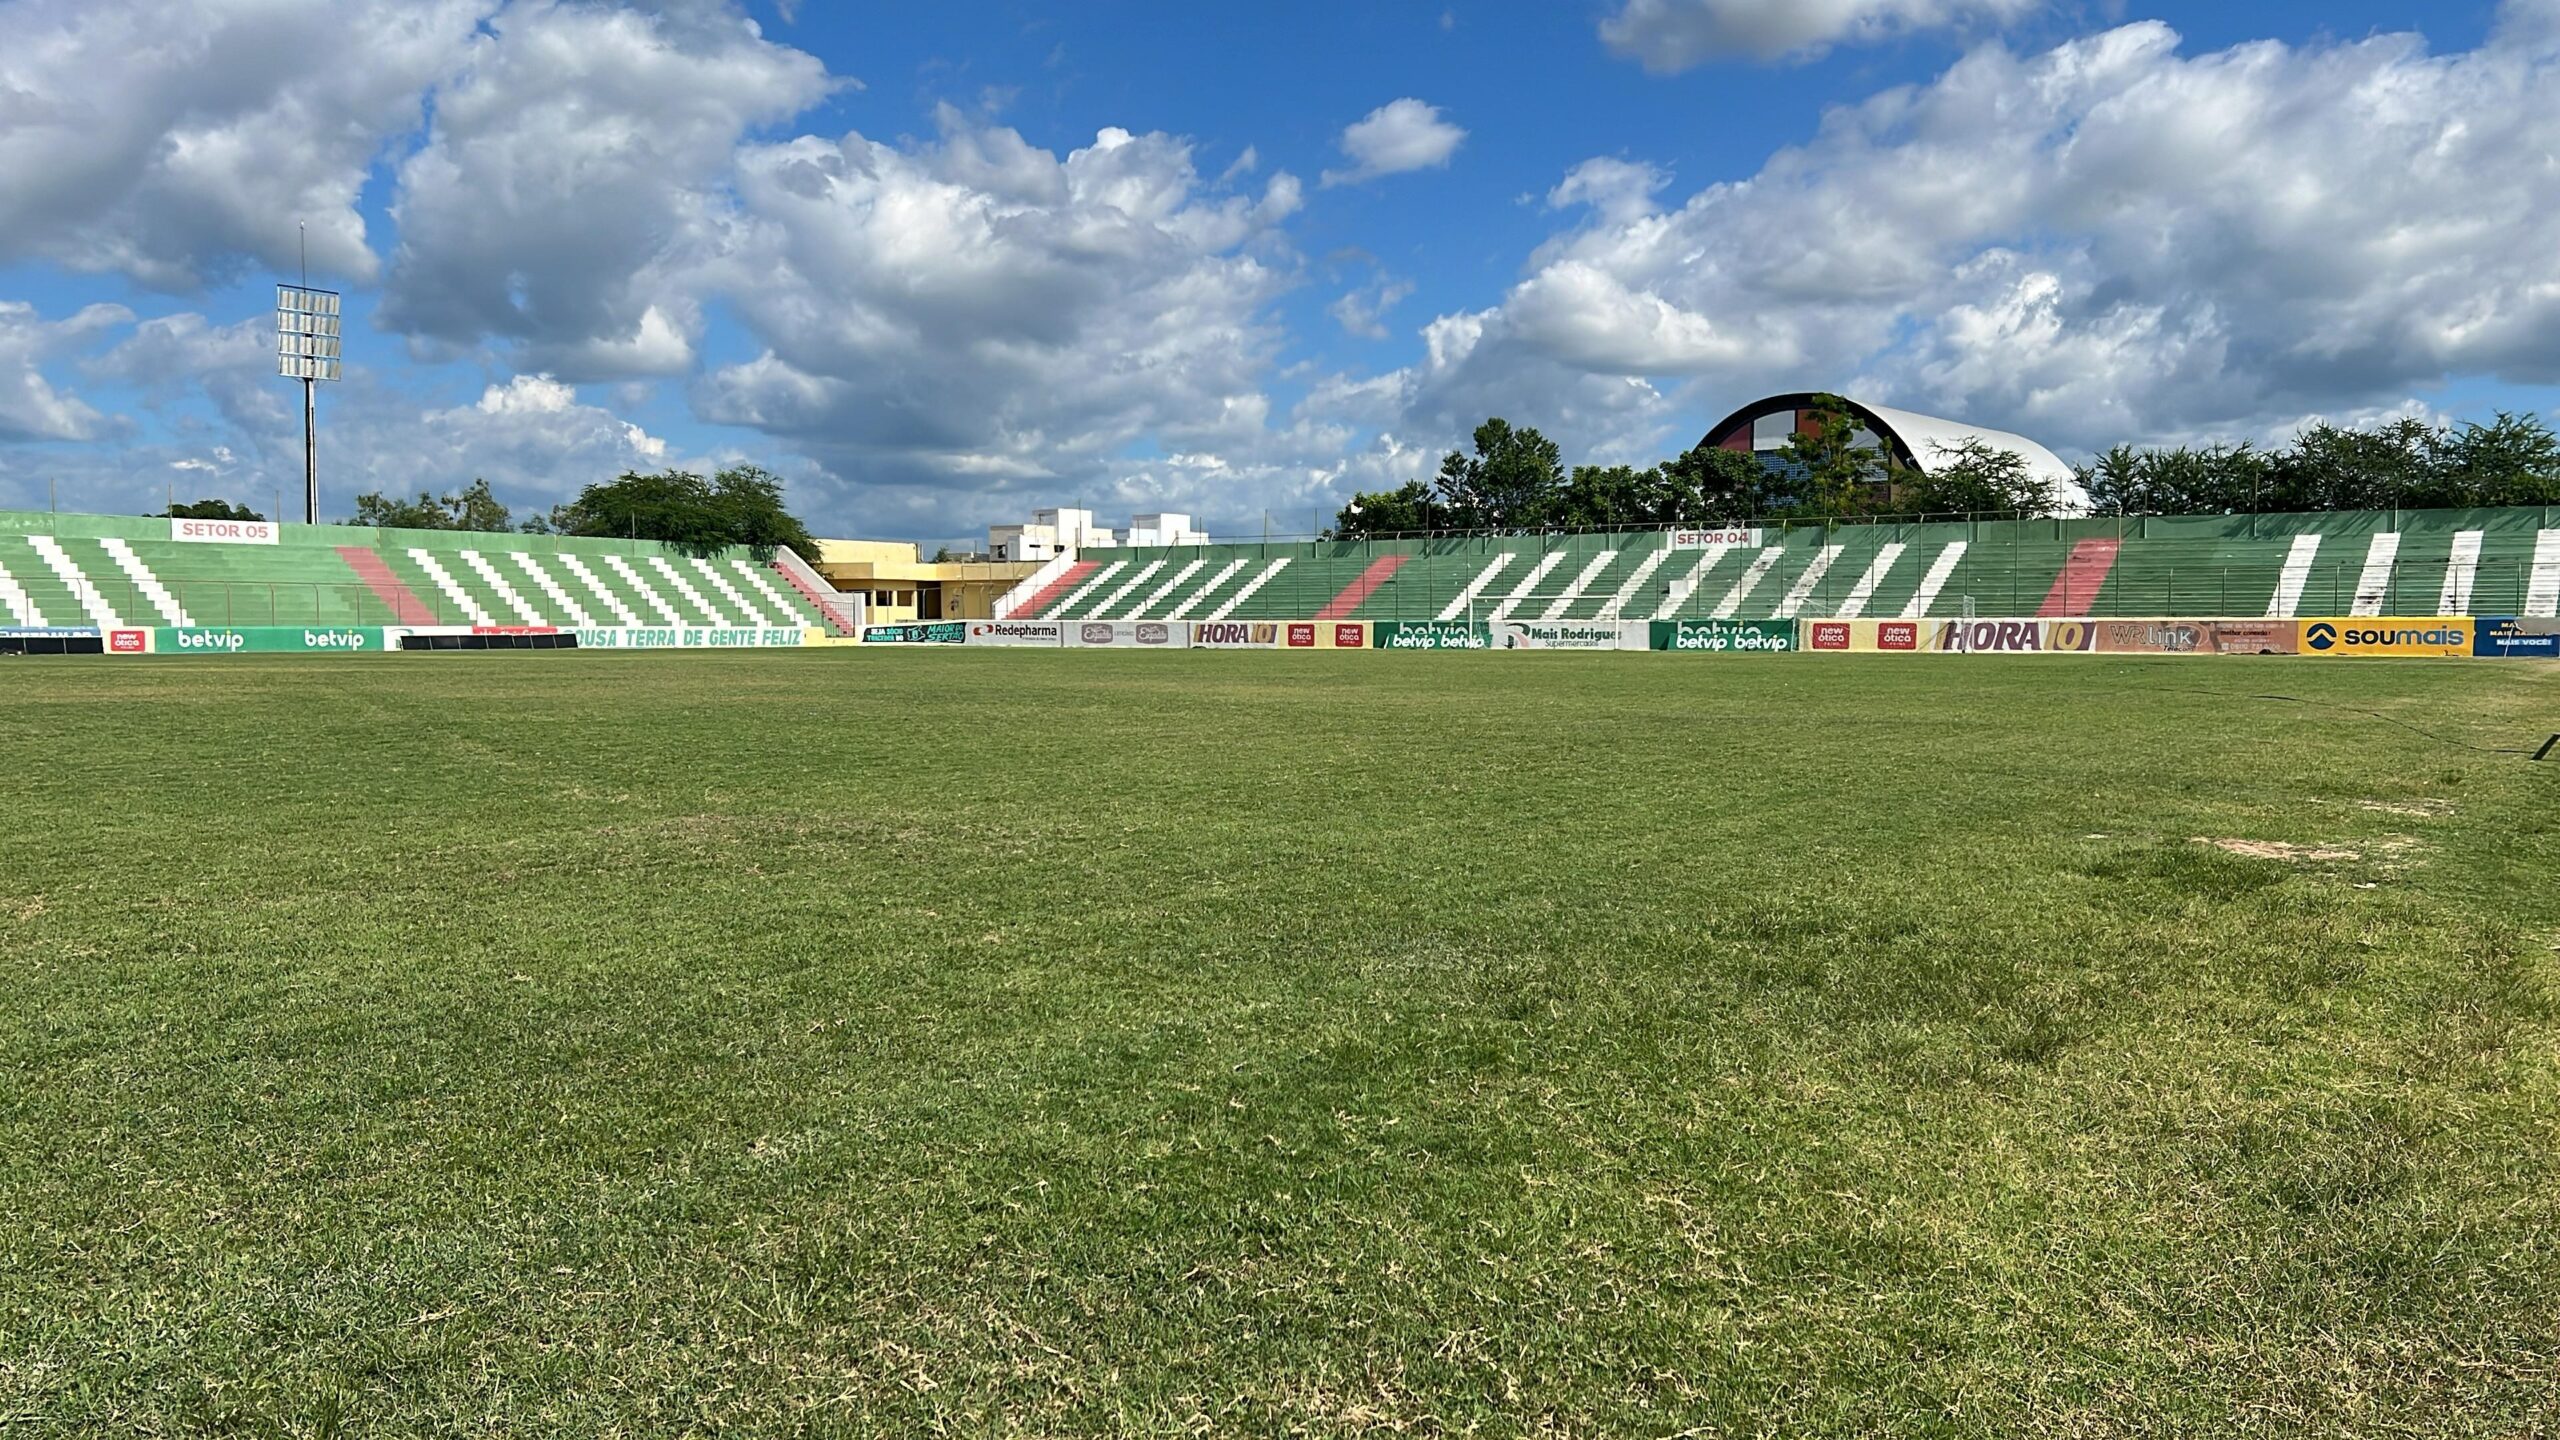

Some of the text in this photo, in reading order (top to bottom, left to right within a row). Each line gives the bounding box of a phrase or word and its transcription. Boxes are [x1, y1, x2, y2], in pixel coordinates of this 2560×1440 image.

[182, 522, 268, 538] SETOR 05
[1677, 532, 1748, 545] SETOR 04
[926, 624, 955, 635] MAIOR
[995, 624, 1057, 638] Redepharma
[1199, 624, 1250, 643] HORA
[1532, 628, 1558, 639] Mais
[1943, 622, 2041, 650] HORA
[2344, 625, 2465, 646] soumais
[177, 629, 364, 652] betvip betvip
[564, 629, 801, 647] OUSA TERRA DE GENTE FELIZ
[1393, 634, 1484, 649] betvip betvip
[1676, 634, 1787, 651] betvip betvip
